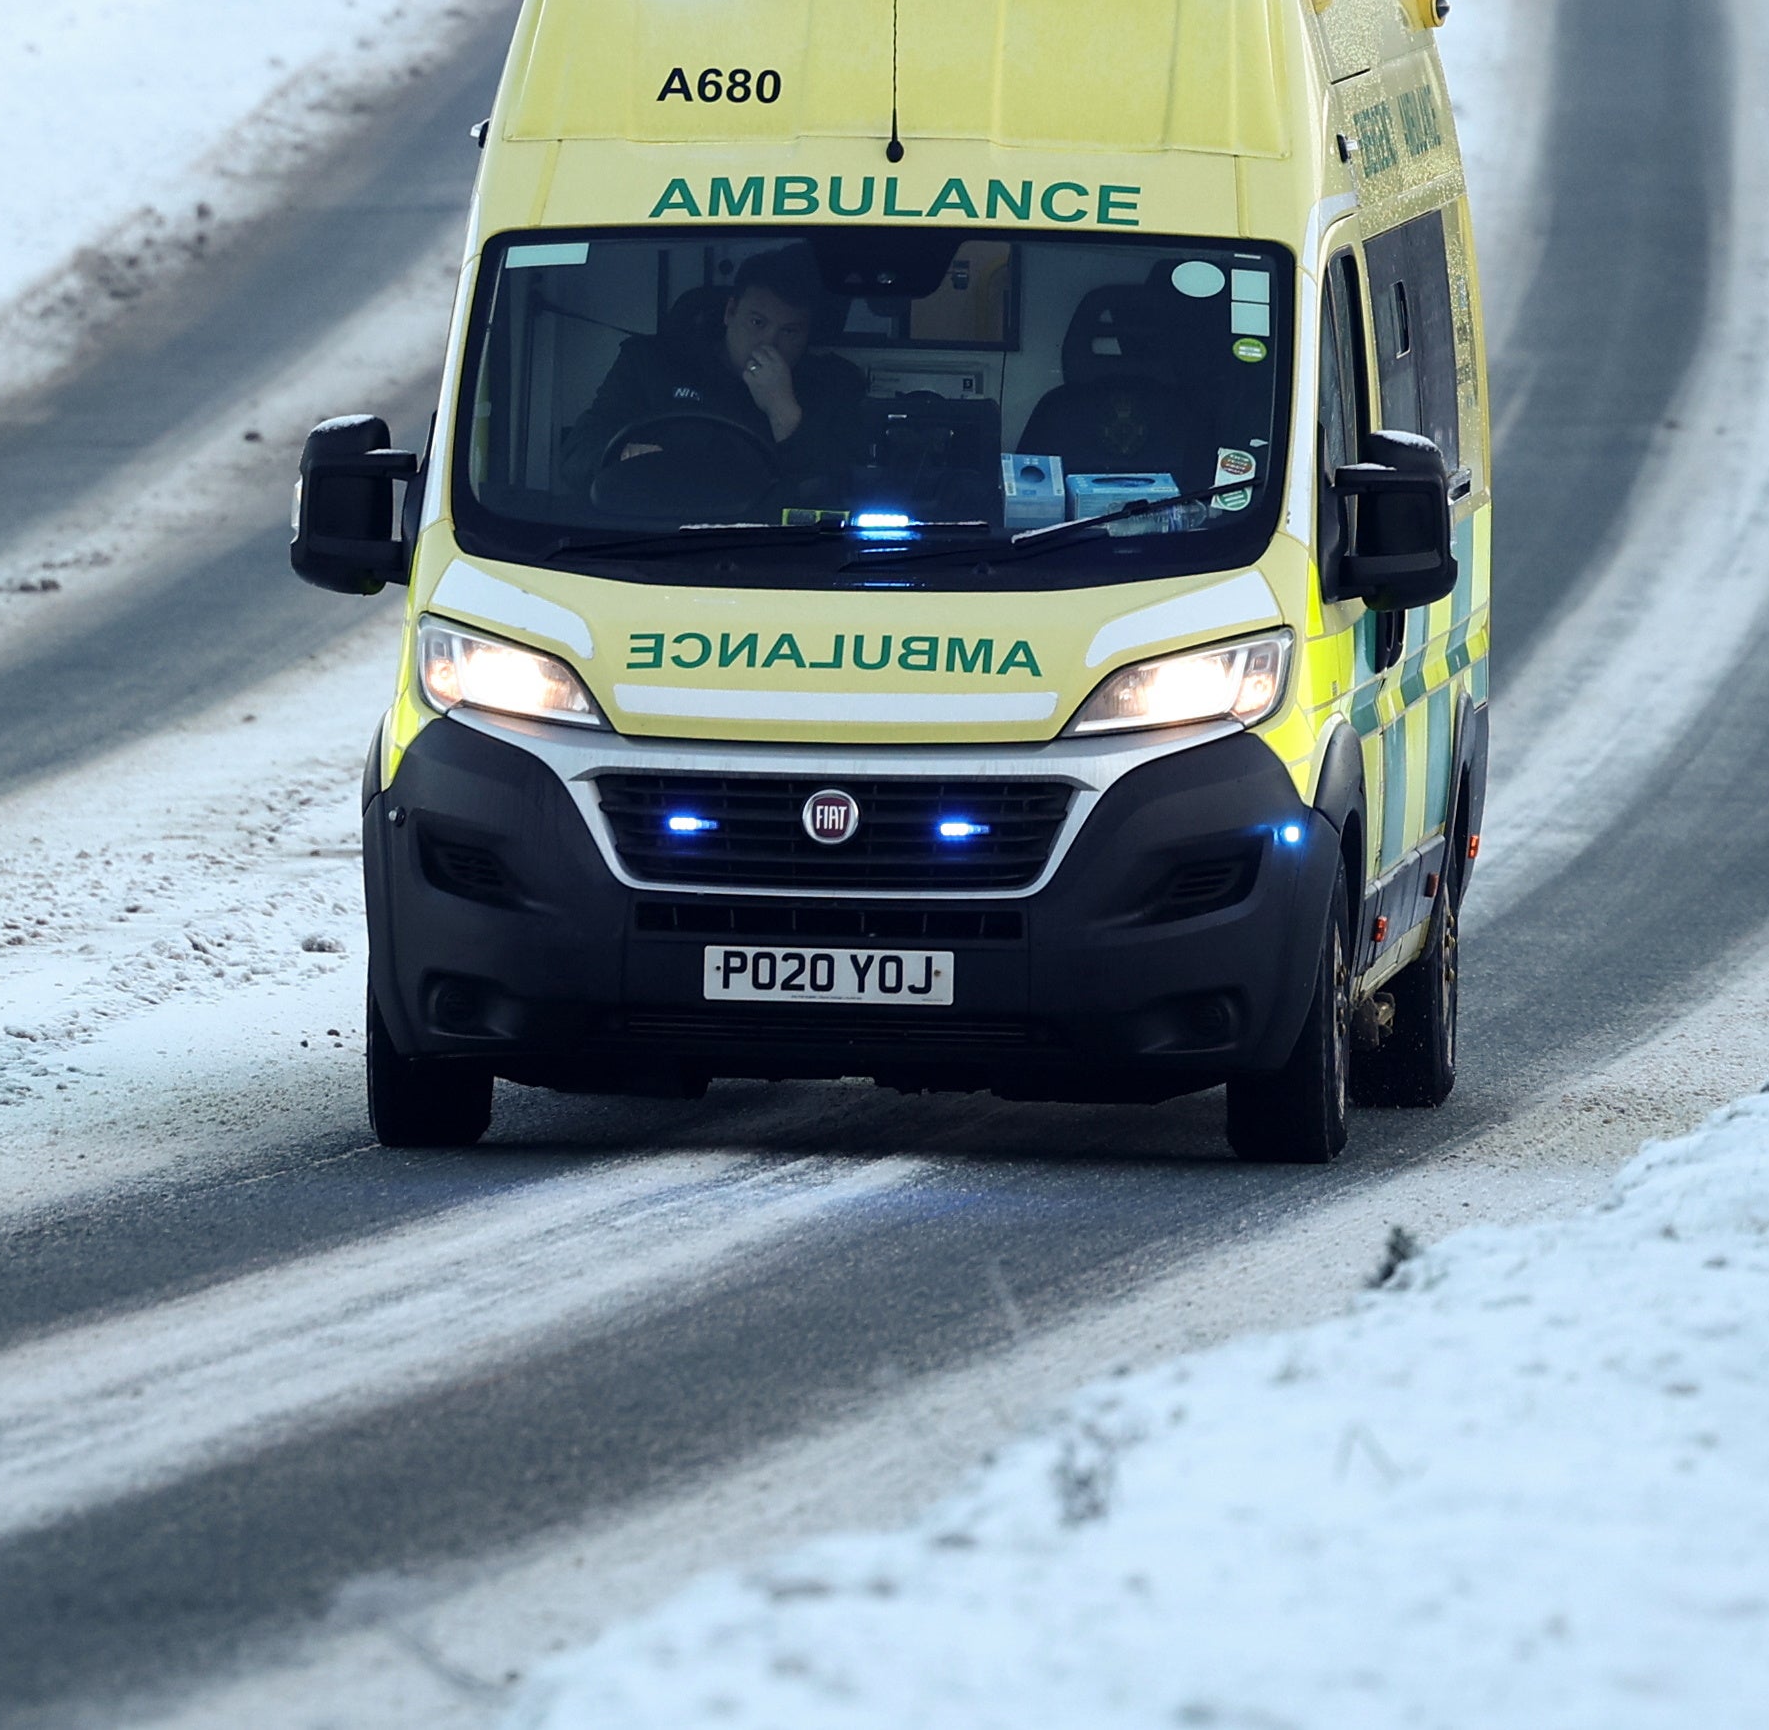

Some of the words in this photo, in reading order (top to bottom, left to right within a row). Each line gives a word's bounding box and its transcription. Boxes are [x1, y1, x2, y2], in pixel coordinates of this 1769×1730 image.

[656, 67, 781, 103] A680
[648, 175, 1142, 226] AMBULANCE
[815, 805, 847, 830] FIAT
[722, 950, 835, 992] PO20
[849, 954, 933, 995] YOJ
